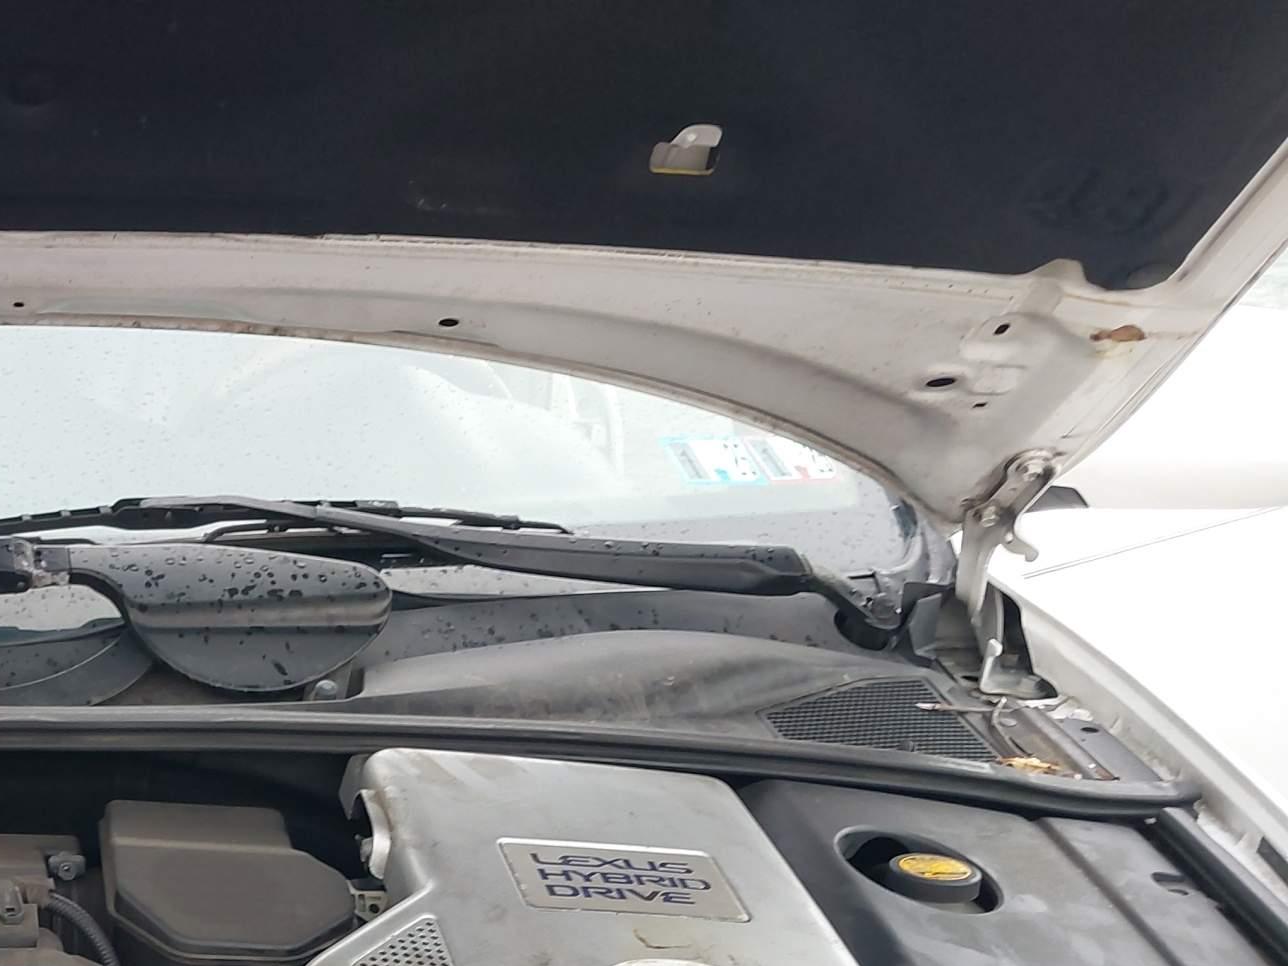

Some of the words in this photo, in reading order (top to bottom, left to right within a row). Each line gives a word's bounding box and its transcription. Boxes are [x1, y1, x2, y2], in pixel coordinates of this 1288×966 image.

[530, 852, 694, 875] LEXUS
[537, 868, 712, 891] HYBRID
[544, 884, 696, 905] DRIVE
